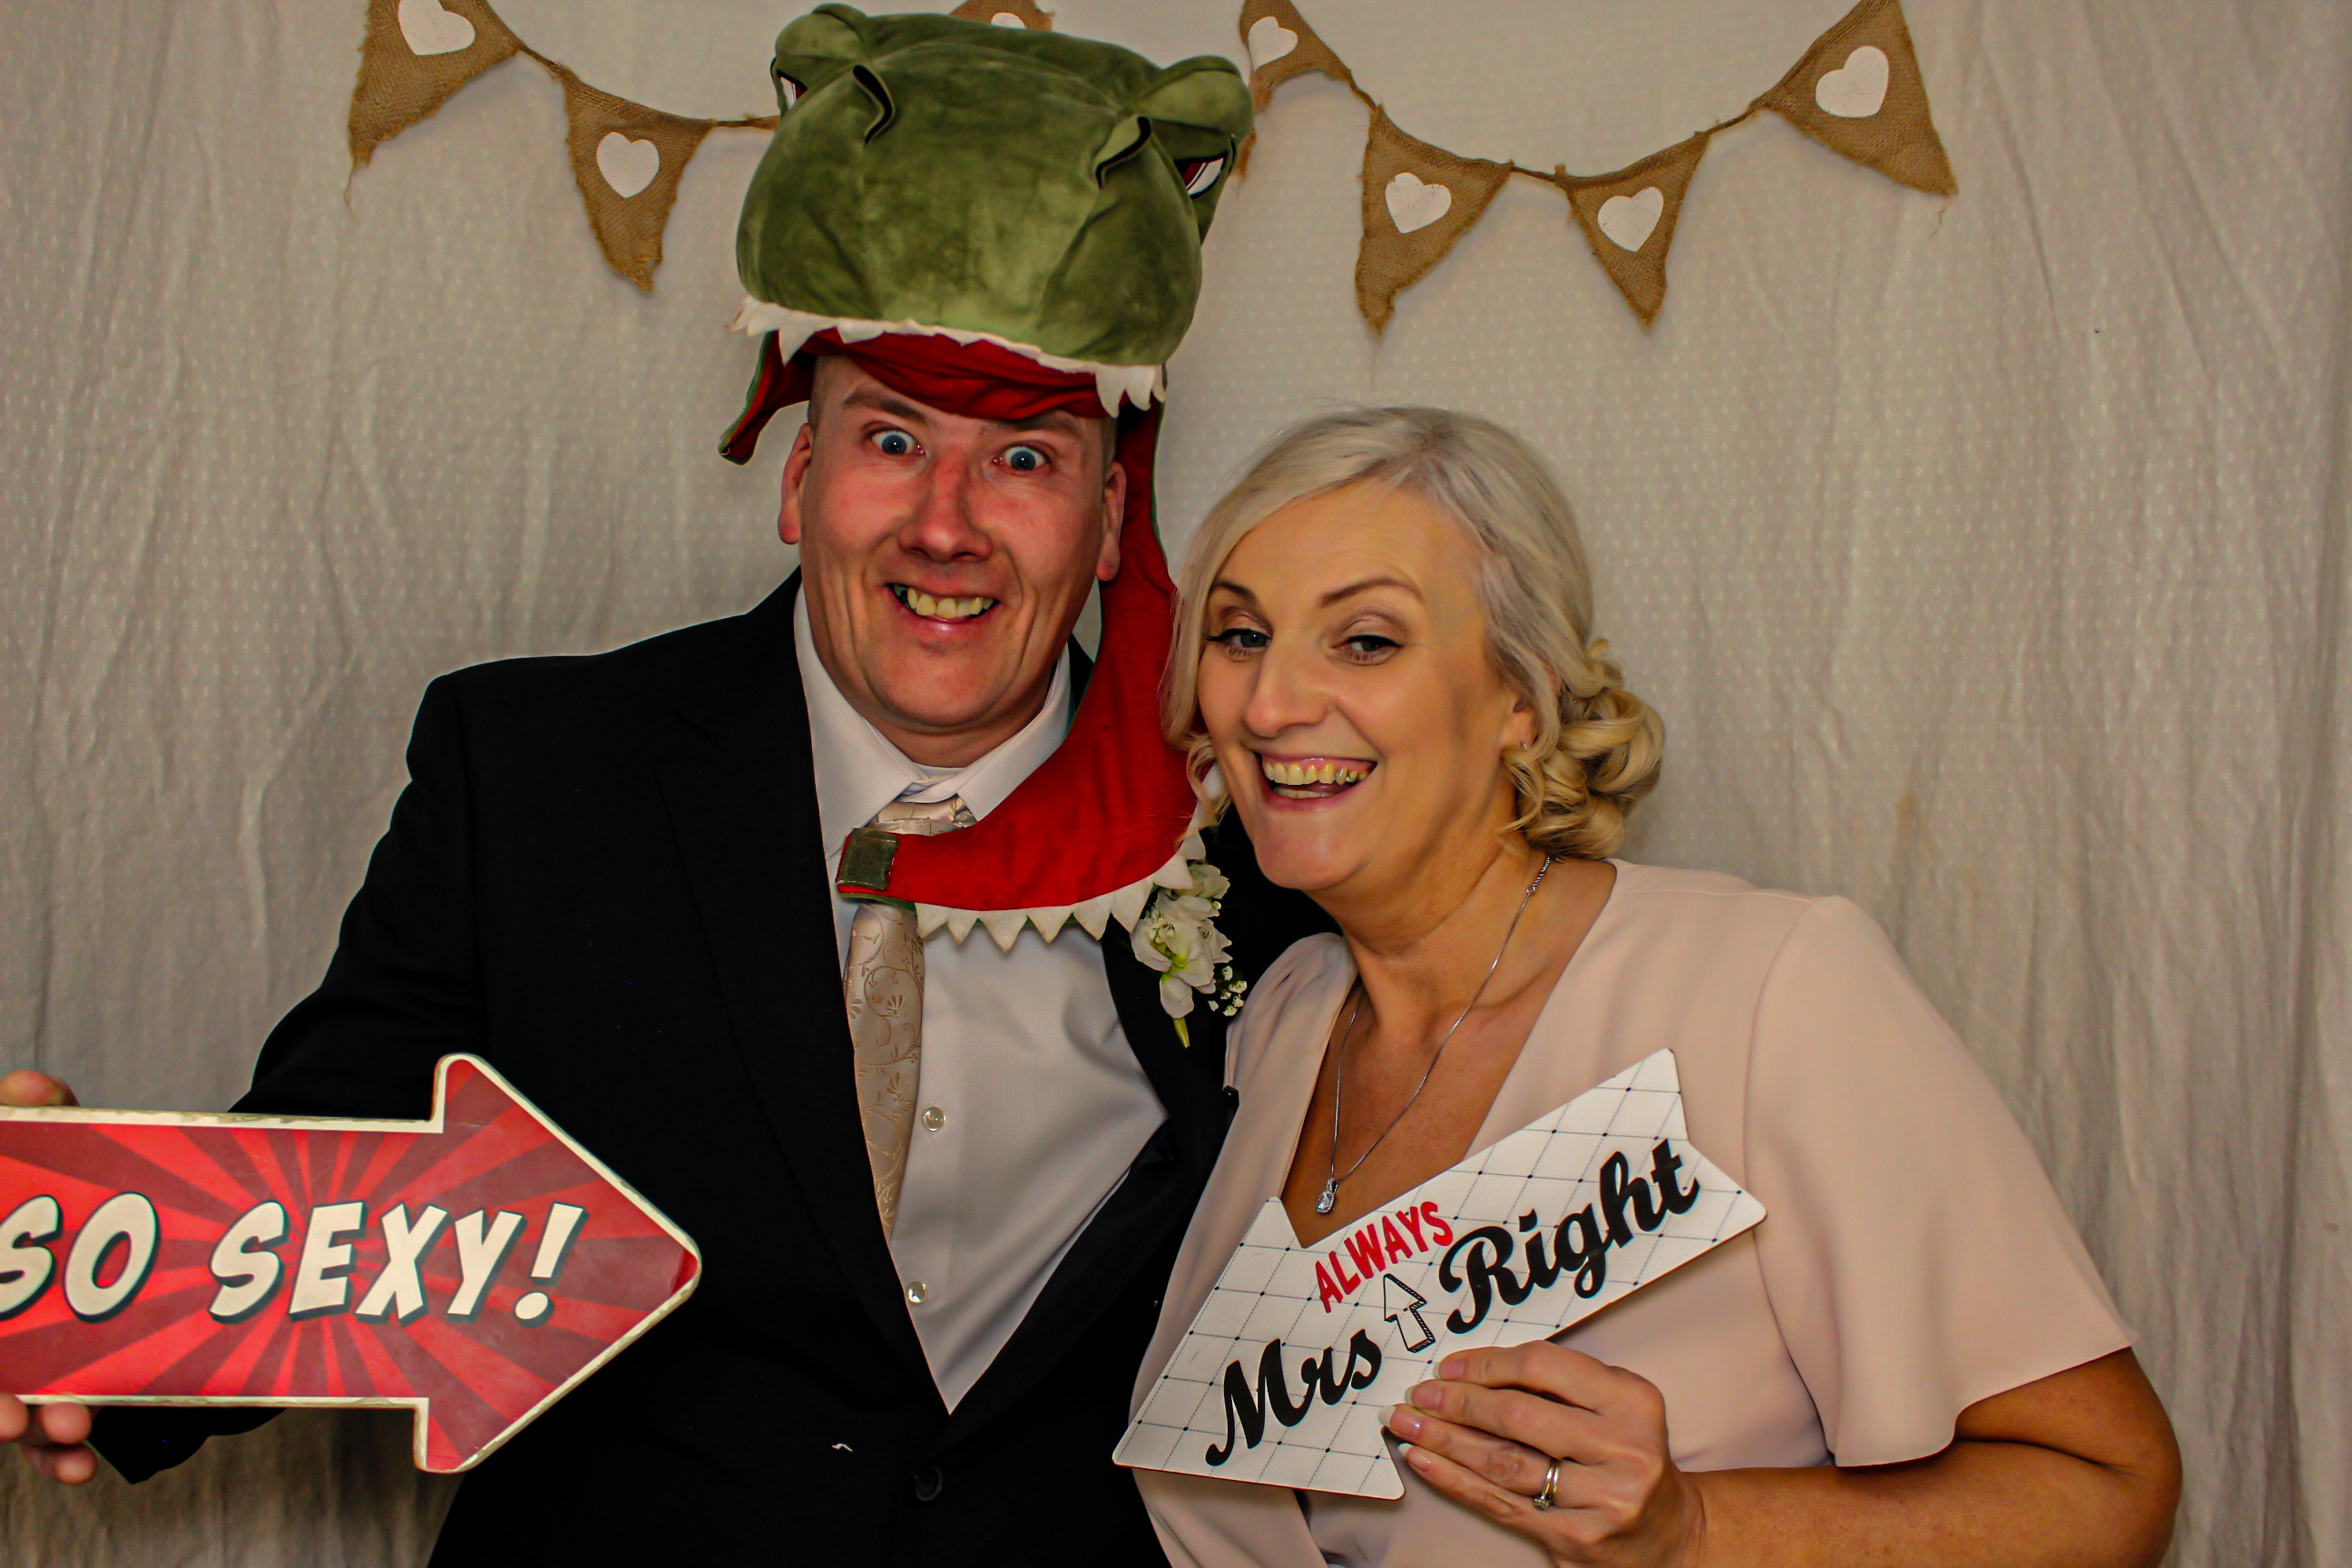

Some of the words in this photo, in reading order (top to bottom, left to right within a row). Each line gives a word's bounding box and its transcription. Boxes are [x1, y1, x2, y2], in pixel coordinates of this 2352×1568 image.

[0, 1192, 161, 1320] SO
[209, 1200, 587, 1324] SEXY!
[1205, 1328, 1381, 1466] Mrs
[1438, 1138, 1700, 1335] Right
[1314, 1201, 1454, 1313] ALWAYS
